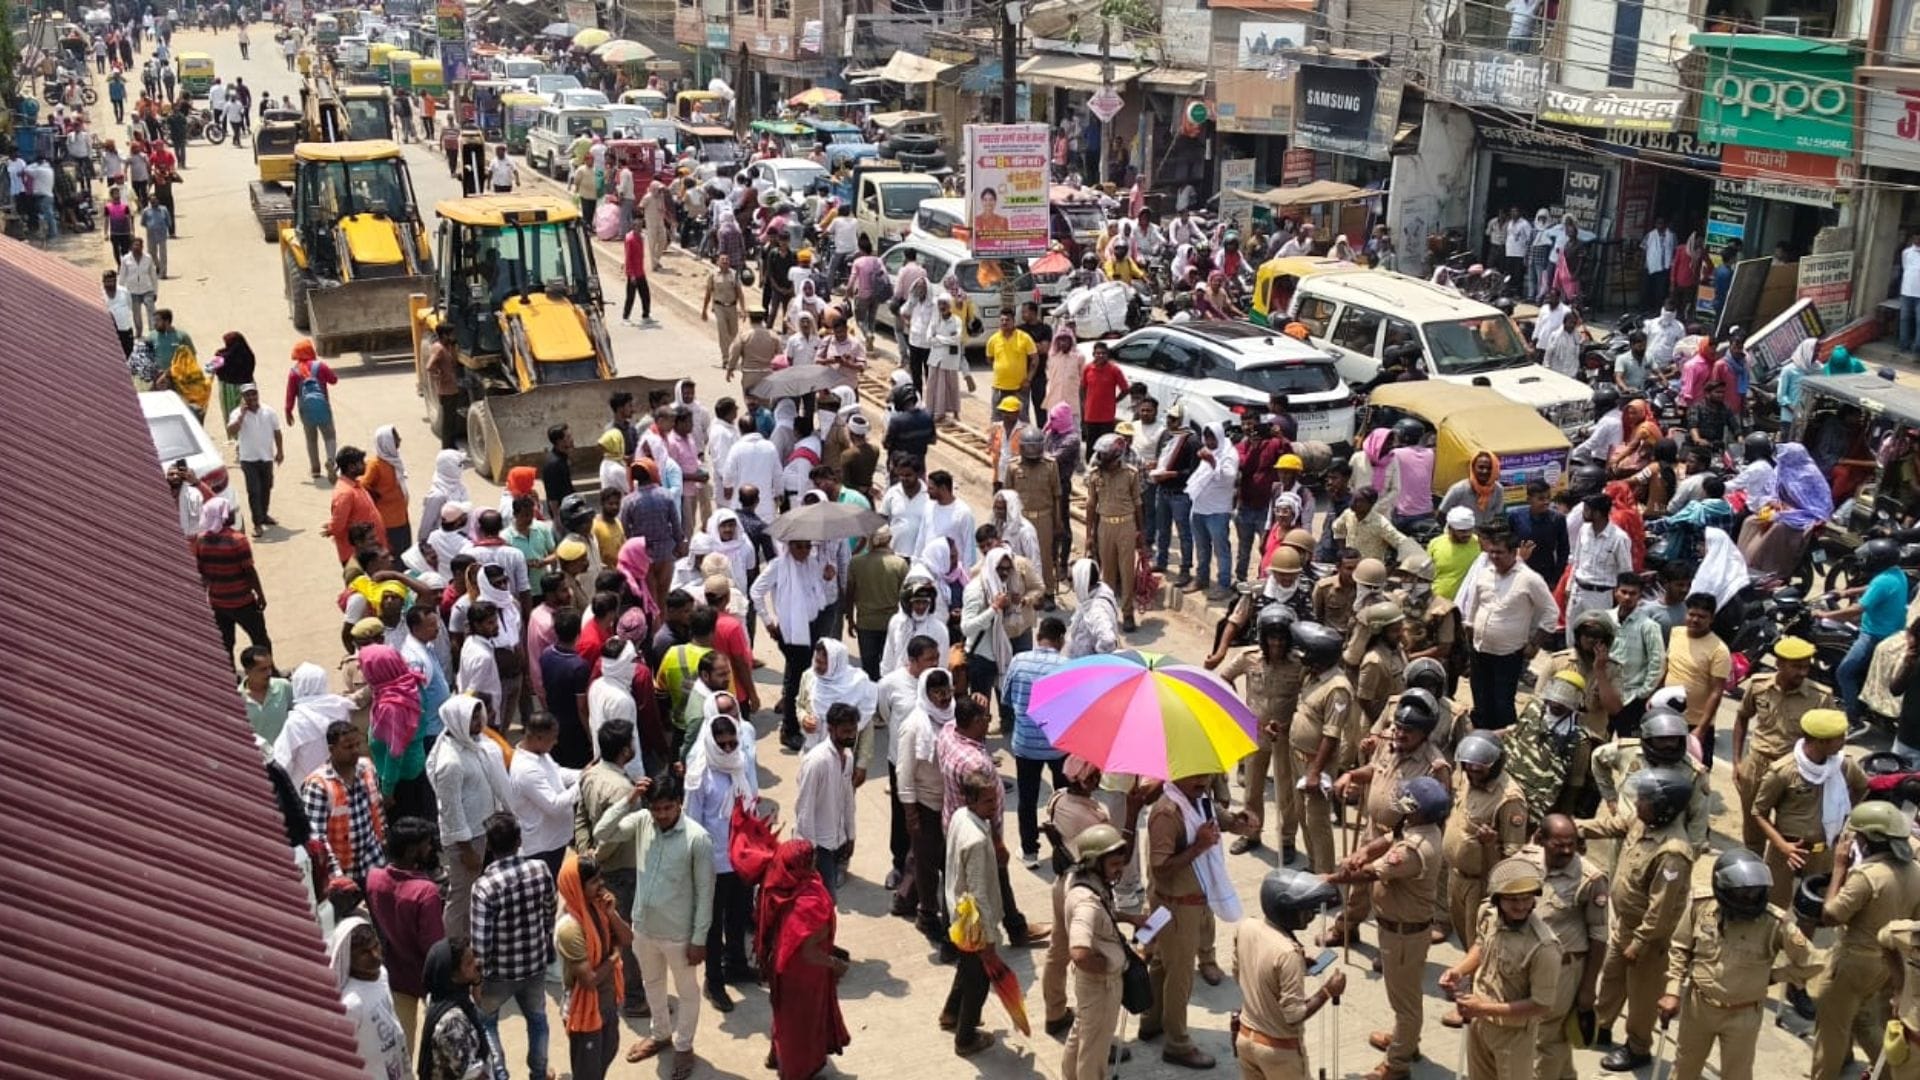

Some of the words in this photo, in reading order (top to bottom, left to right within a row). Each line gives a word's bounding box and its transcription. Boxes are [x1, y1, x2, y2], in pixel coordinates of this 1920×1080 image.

[1306, 89, 1361, 112] SAMSUNG
[1548, 91, 1591, 113] राज
[1605, 128, 1673, 151] HOTEL
[1678, 133, 1721, 157] RAJ
[1569, 172, 1600, 190] राज
